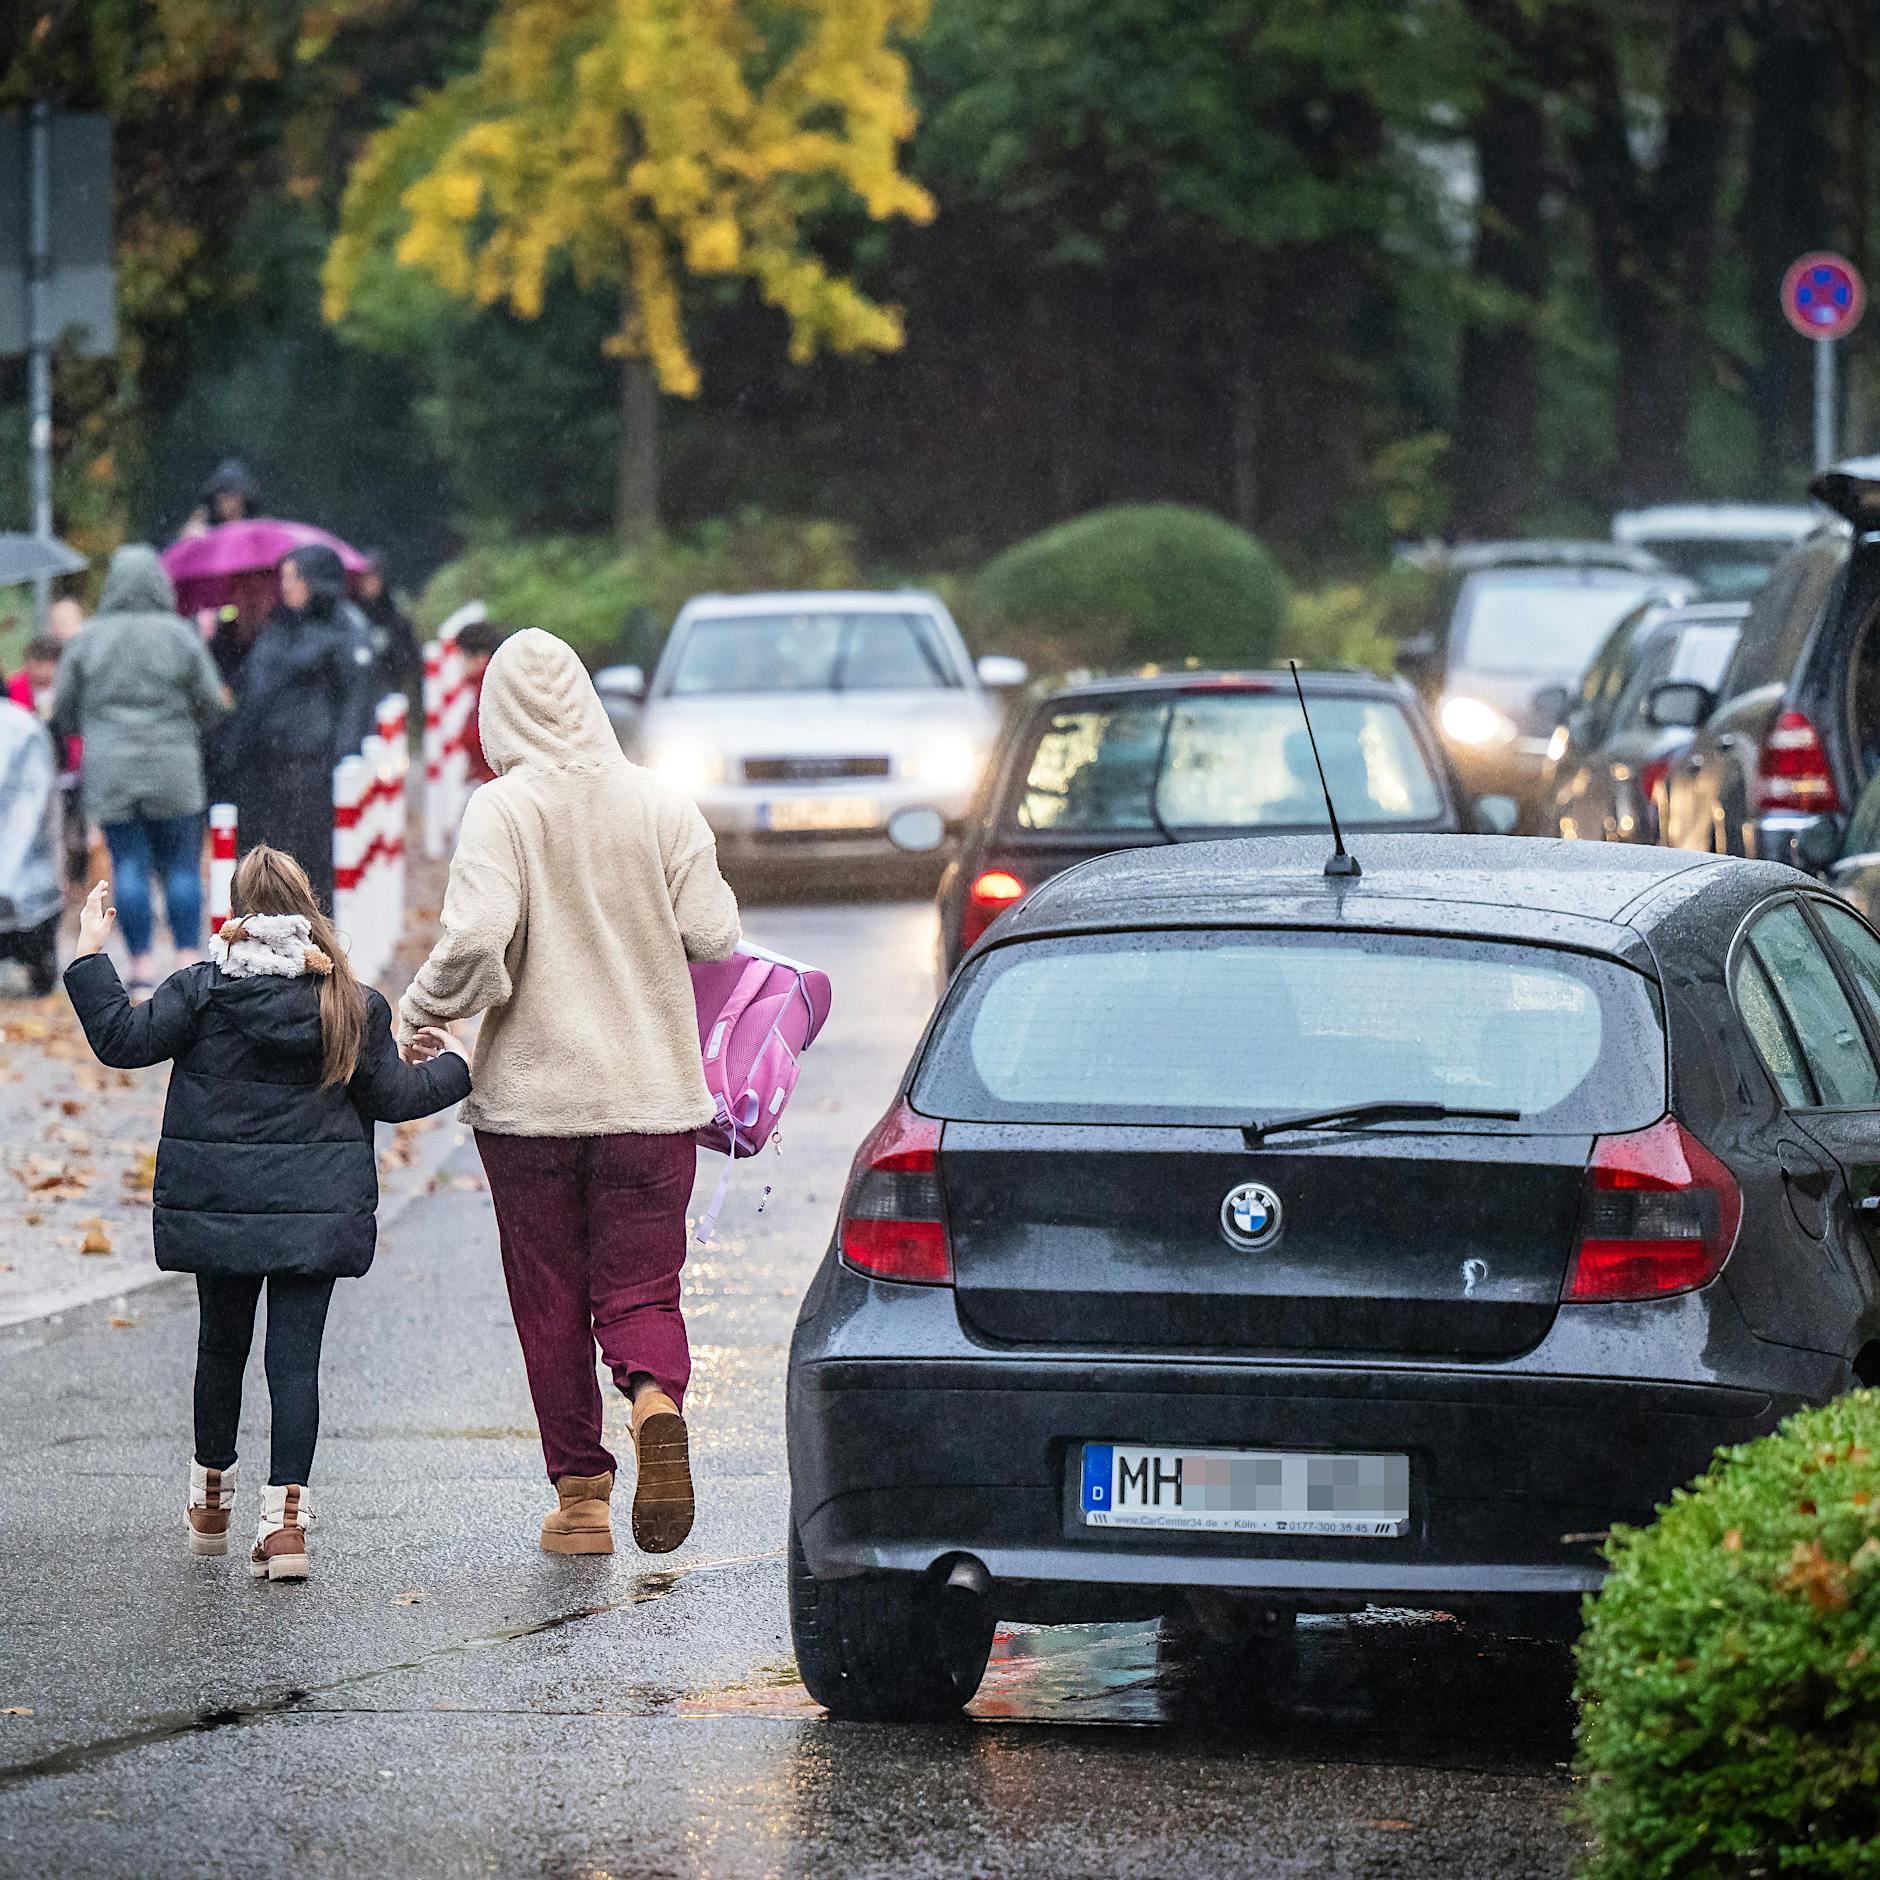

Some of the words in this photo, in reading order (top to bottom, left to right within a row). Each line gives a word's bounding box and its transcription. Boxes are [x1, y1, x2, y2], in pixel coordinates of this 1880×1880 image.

[1230, 1190, 1271, 1208] BMW
[1092, 1485, 1104, 1501] D
[1118, 1456, 1183, 1505] MH
[1234, 1519, 1256, 1530] Köln
